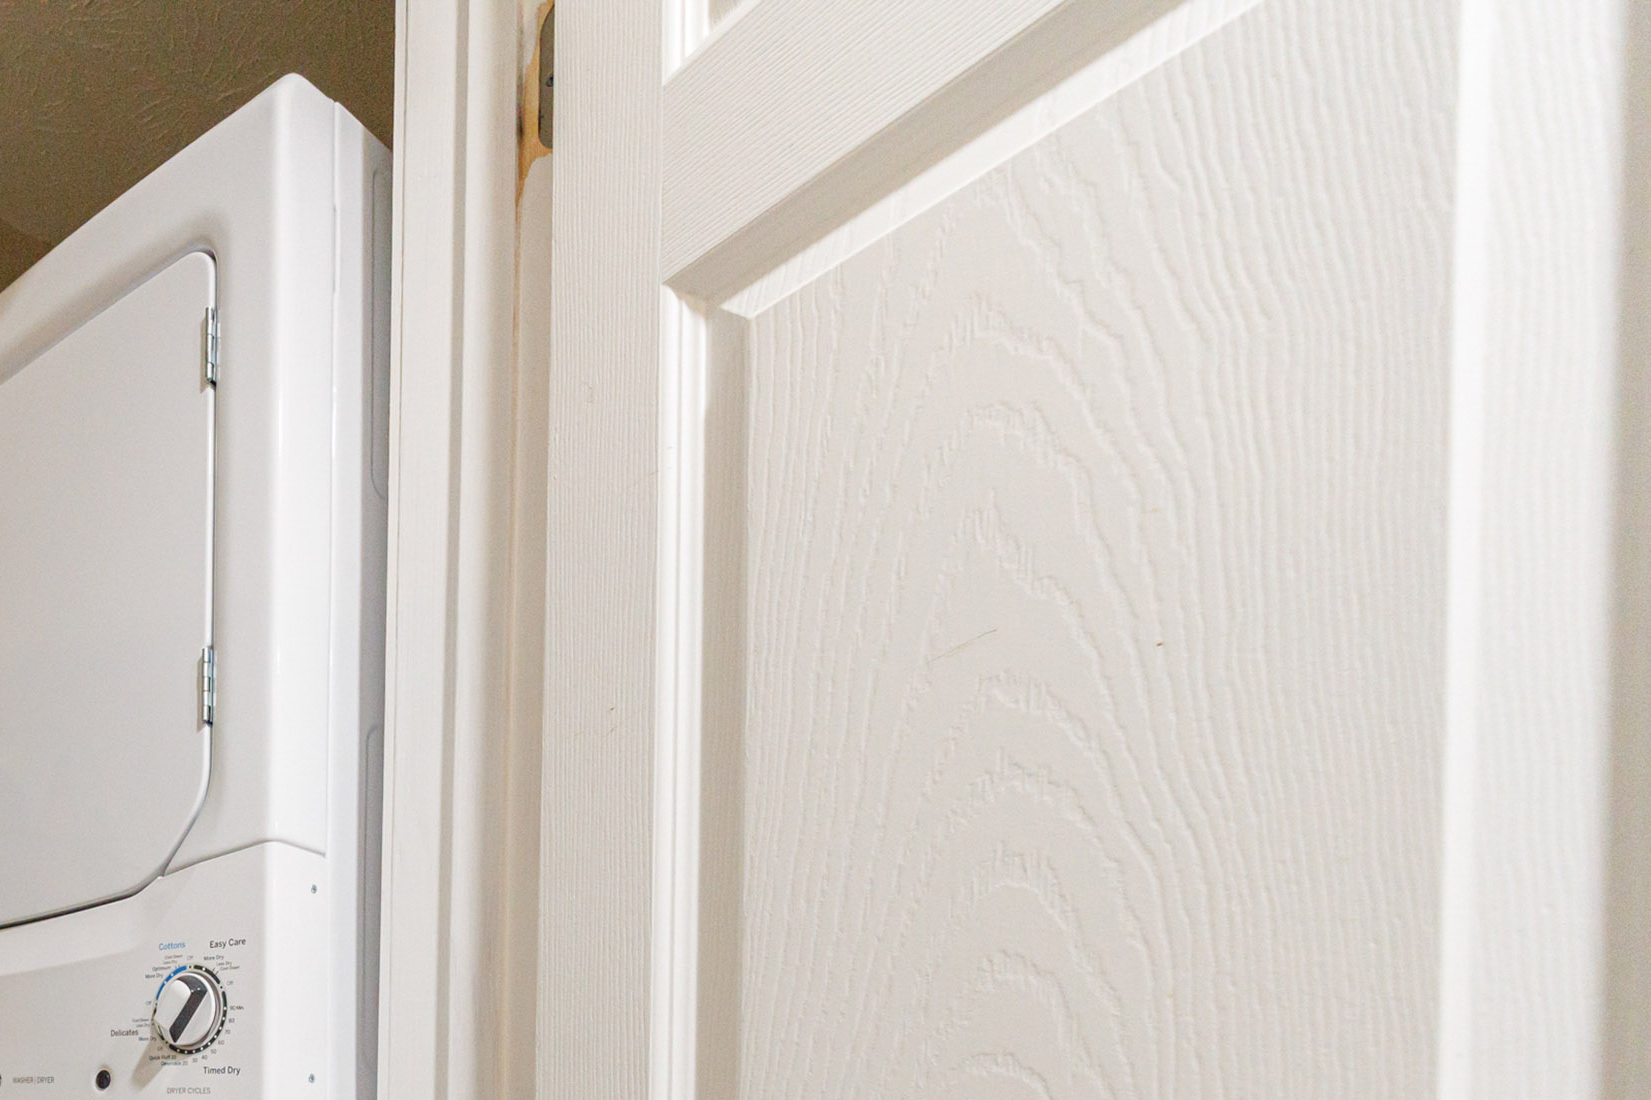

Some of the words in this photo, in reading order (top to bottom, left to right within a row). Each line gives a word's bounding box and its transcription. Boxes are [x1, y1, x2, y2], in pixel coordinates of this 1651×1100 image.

[158, 941, 186, 951] Cottons
[209, 940, 227, 949] Easy
[229, 938, 246, 947] Care
[110, 1029, 139, 1037] Delicates
[203, 1066, 226, 1074] Timed
[227, 1065, 241, 1076] Dry
